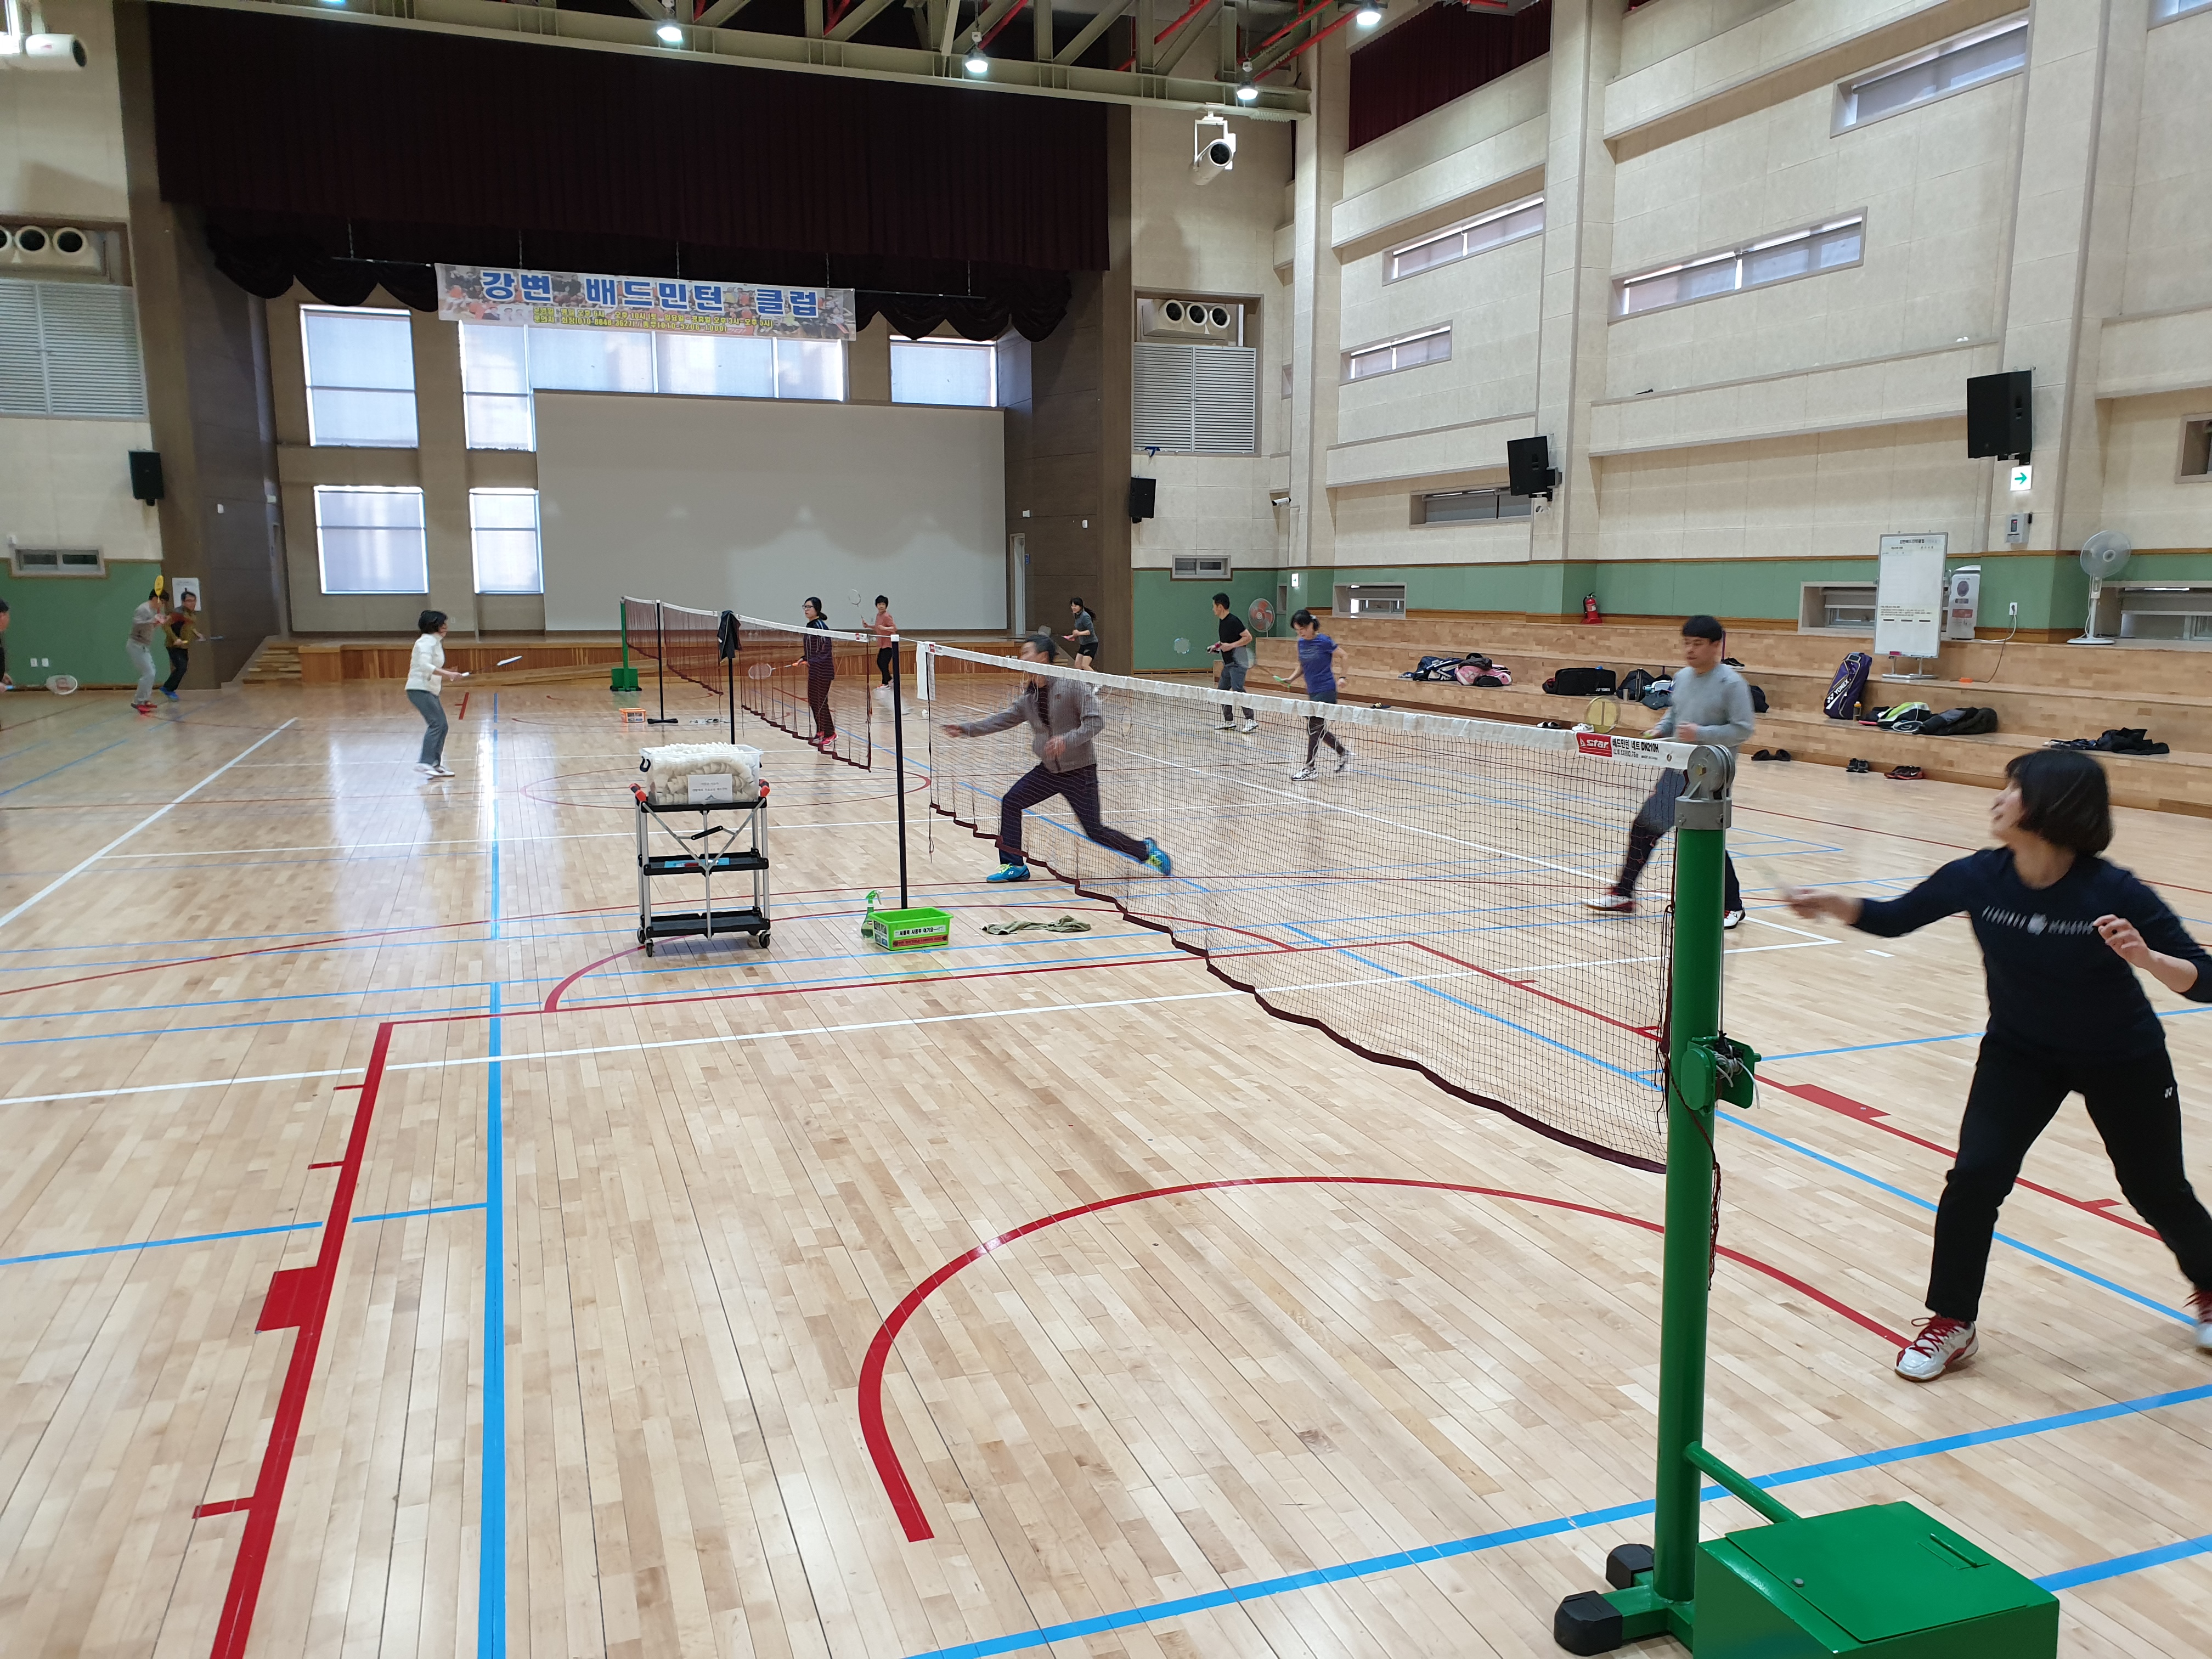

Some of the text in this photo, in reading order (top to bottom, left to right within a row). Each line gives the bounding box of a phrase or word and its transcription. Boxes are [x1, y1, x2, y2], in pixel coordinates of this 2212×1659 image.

[481, 270, 818, 318] 강변 배드민턴 클럽
[561, 308, 575, 317] 평일
[577, 309, 591, 317] 오후
[664, 314, 684, 322] 일요일
[692, 315, 711, 324] 공휴일
[1834, 679, 1850, 695] YONEX
[1587, 738, 1609, 749] star
[1612, 738, 1659, 753] 배드민턴 네트 DN210H
